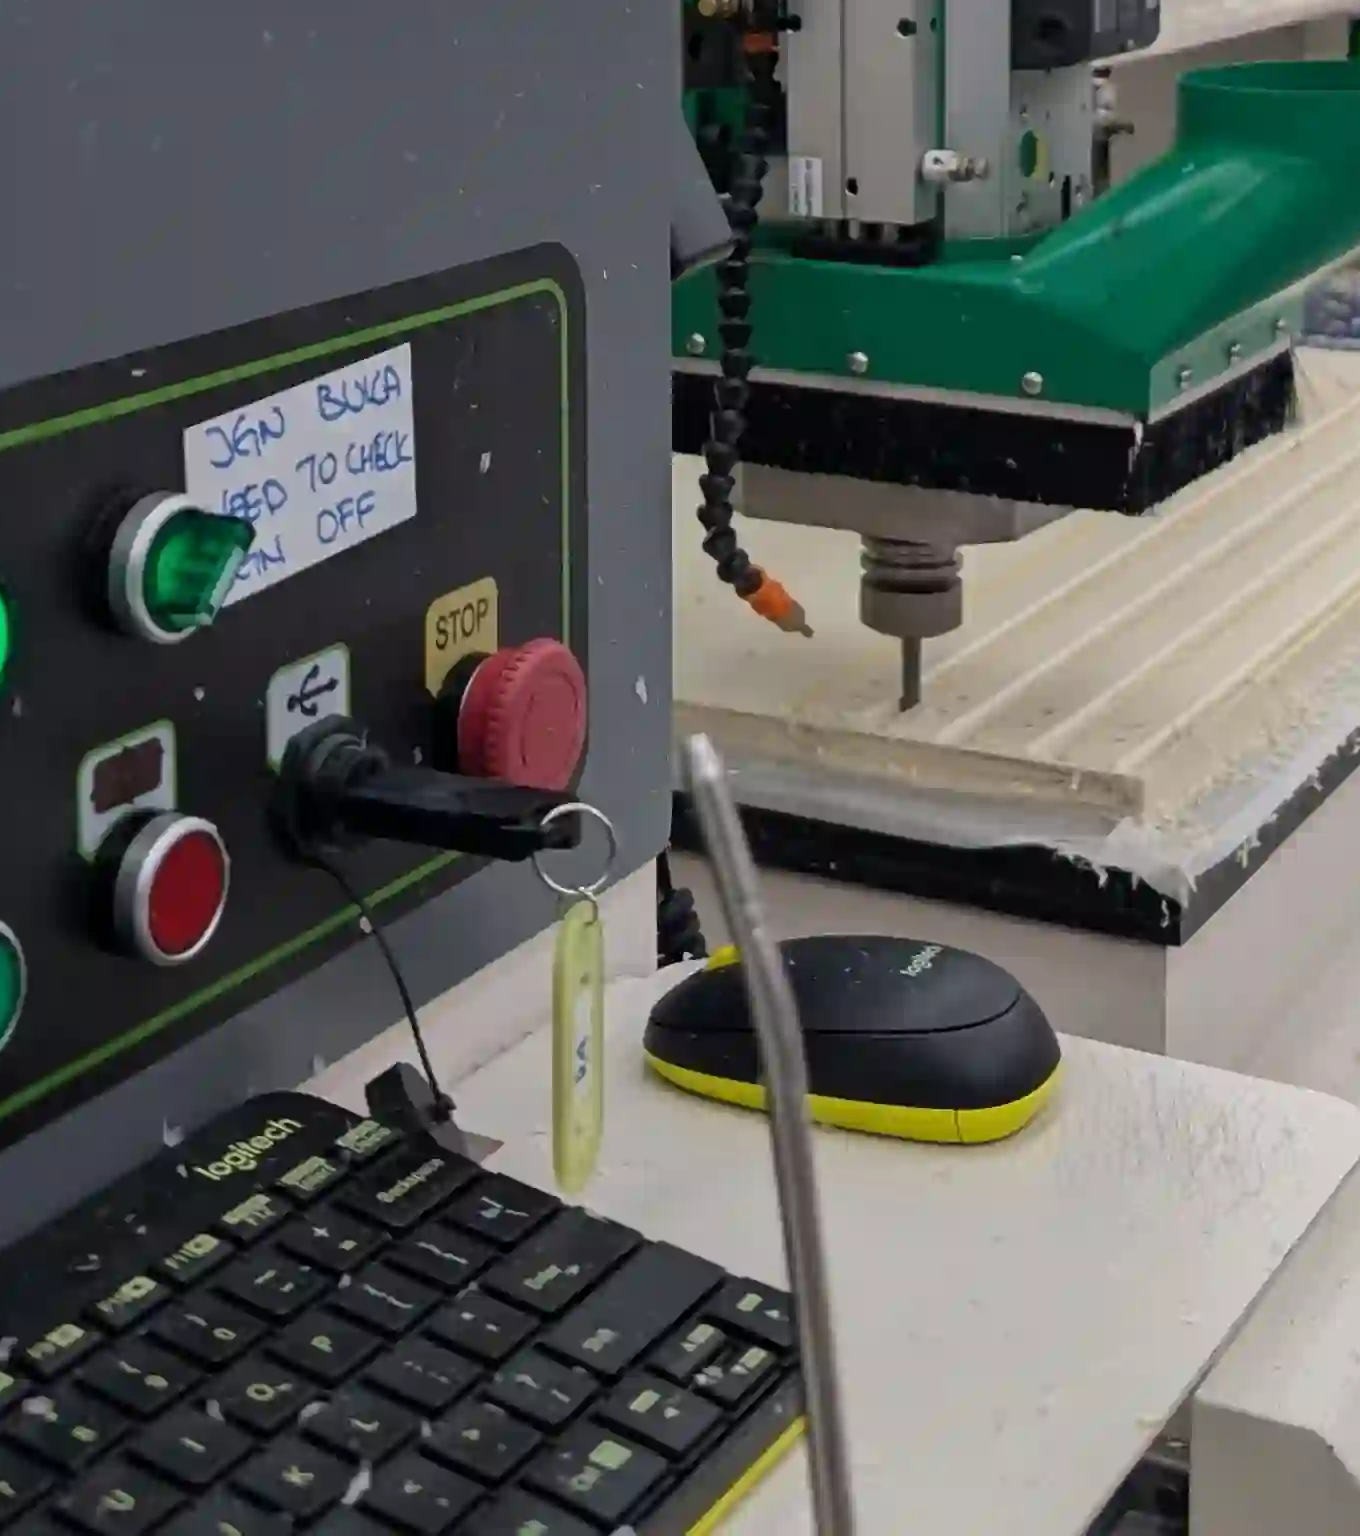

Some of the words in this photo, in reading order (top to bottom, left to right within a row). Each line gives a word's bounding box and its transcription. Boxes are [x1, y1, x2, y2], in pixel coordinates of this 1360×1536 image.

[315, 365, 402, 421] BUKA
[296, 452, 339, 493] TO
[344, 431, 413, 476] CHECK
[315, 489, 376, 545] OFF
[434, 597, 490, 651] STOP
[192, 1117, 306, 1182] logitech
